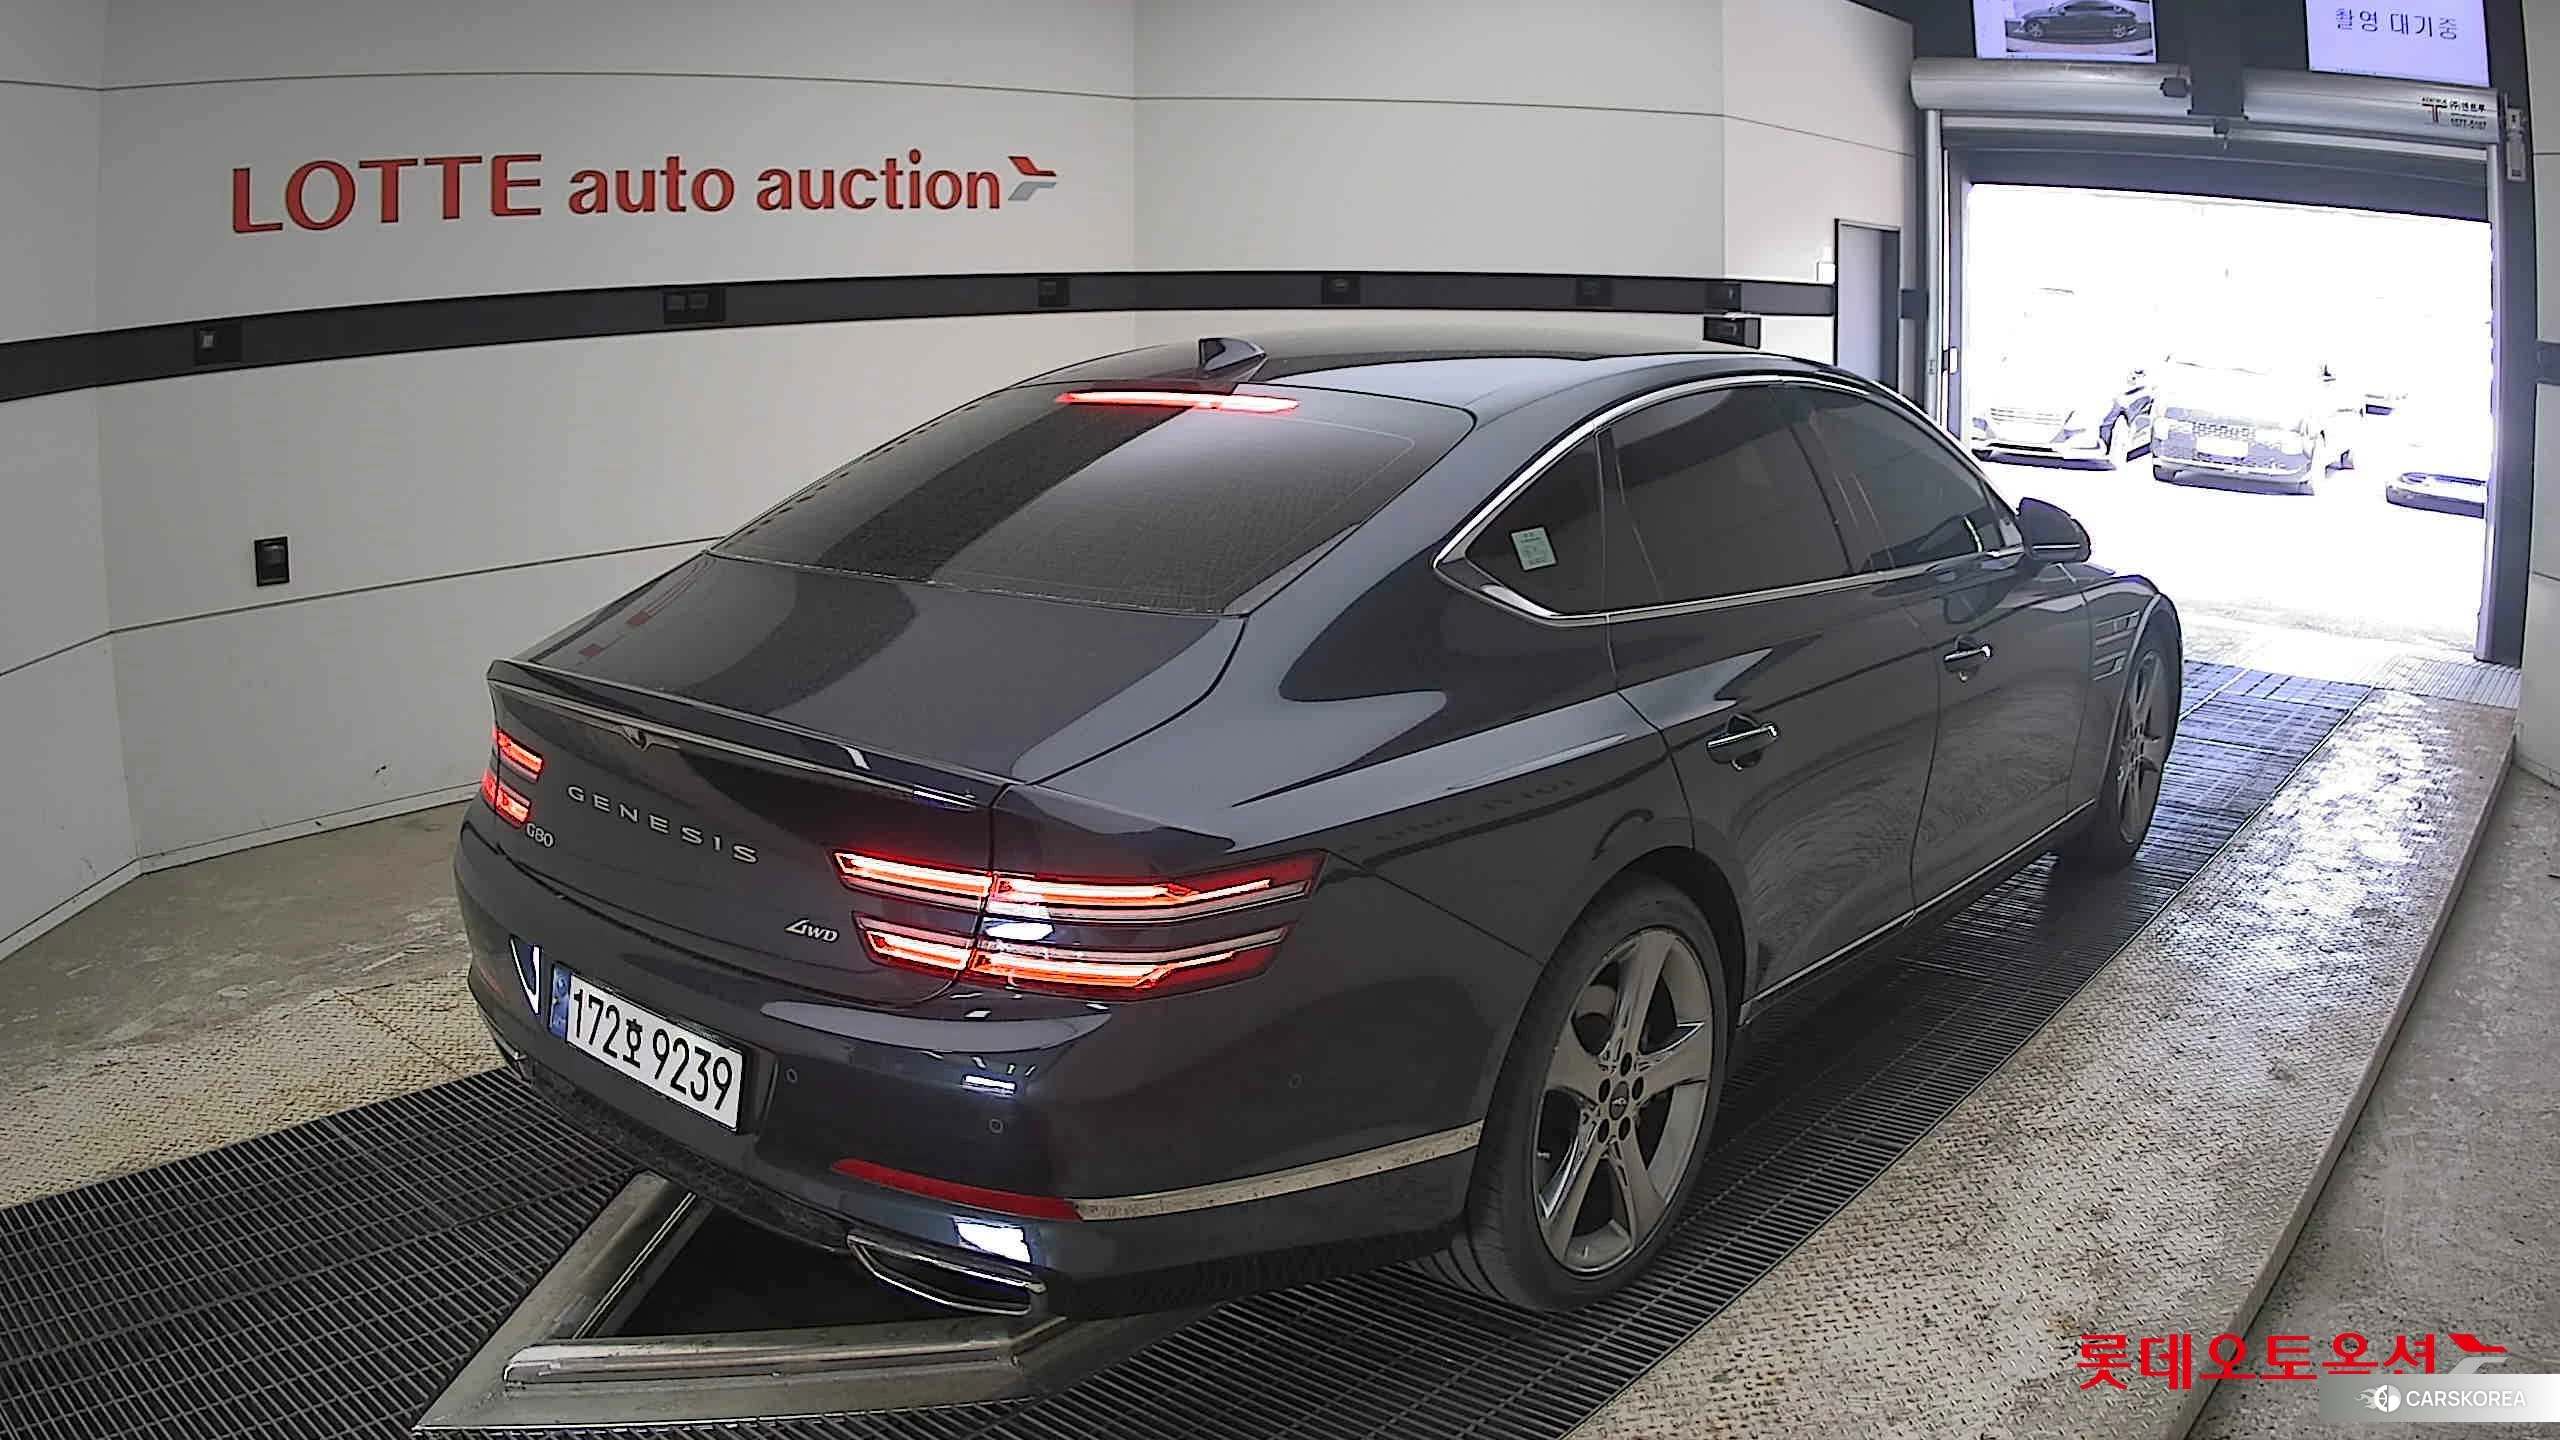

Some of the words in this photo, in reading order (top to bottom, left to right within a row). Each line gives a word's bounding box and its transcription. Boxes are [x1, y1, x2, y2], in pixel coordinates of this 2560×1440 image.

[2335, 8, 2379, 32] 촬영
[231, 153, 544, 234] LOTTE
[567, 155, 735, 215] auto
[756, 148, 1002, 212] auction
[525, 822, 555, 849] G80
[567, 785, 758, 864] GENESIS
[784, 919, 839, 942] 4WD
[573, 988, 643, 1069] 172호
[652, 1028, 733, 1111] 9239
